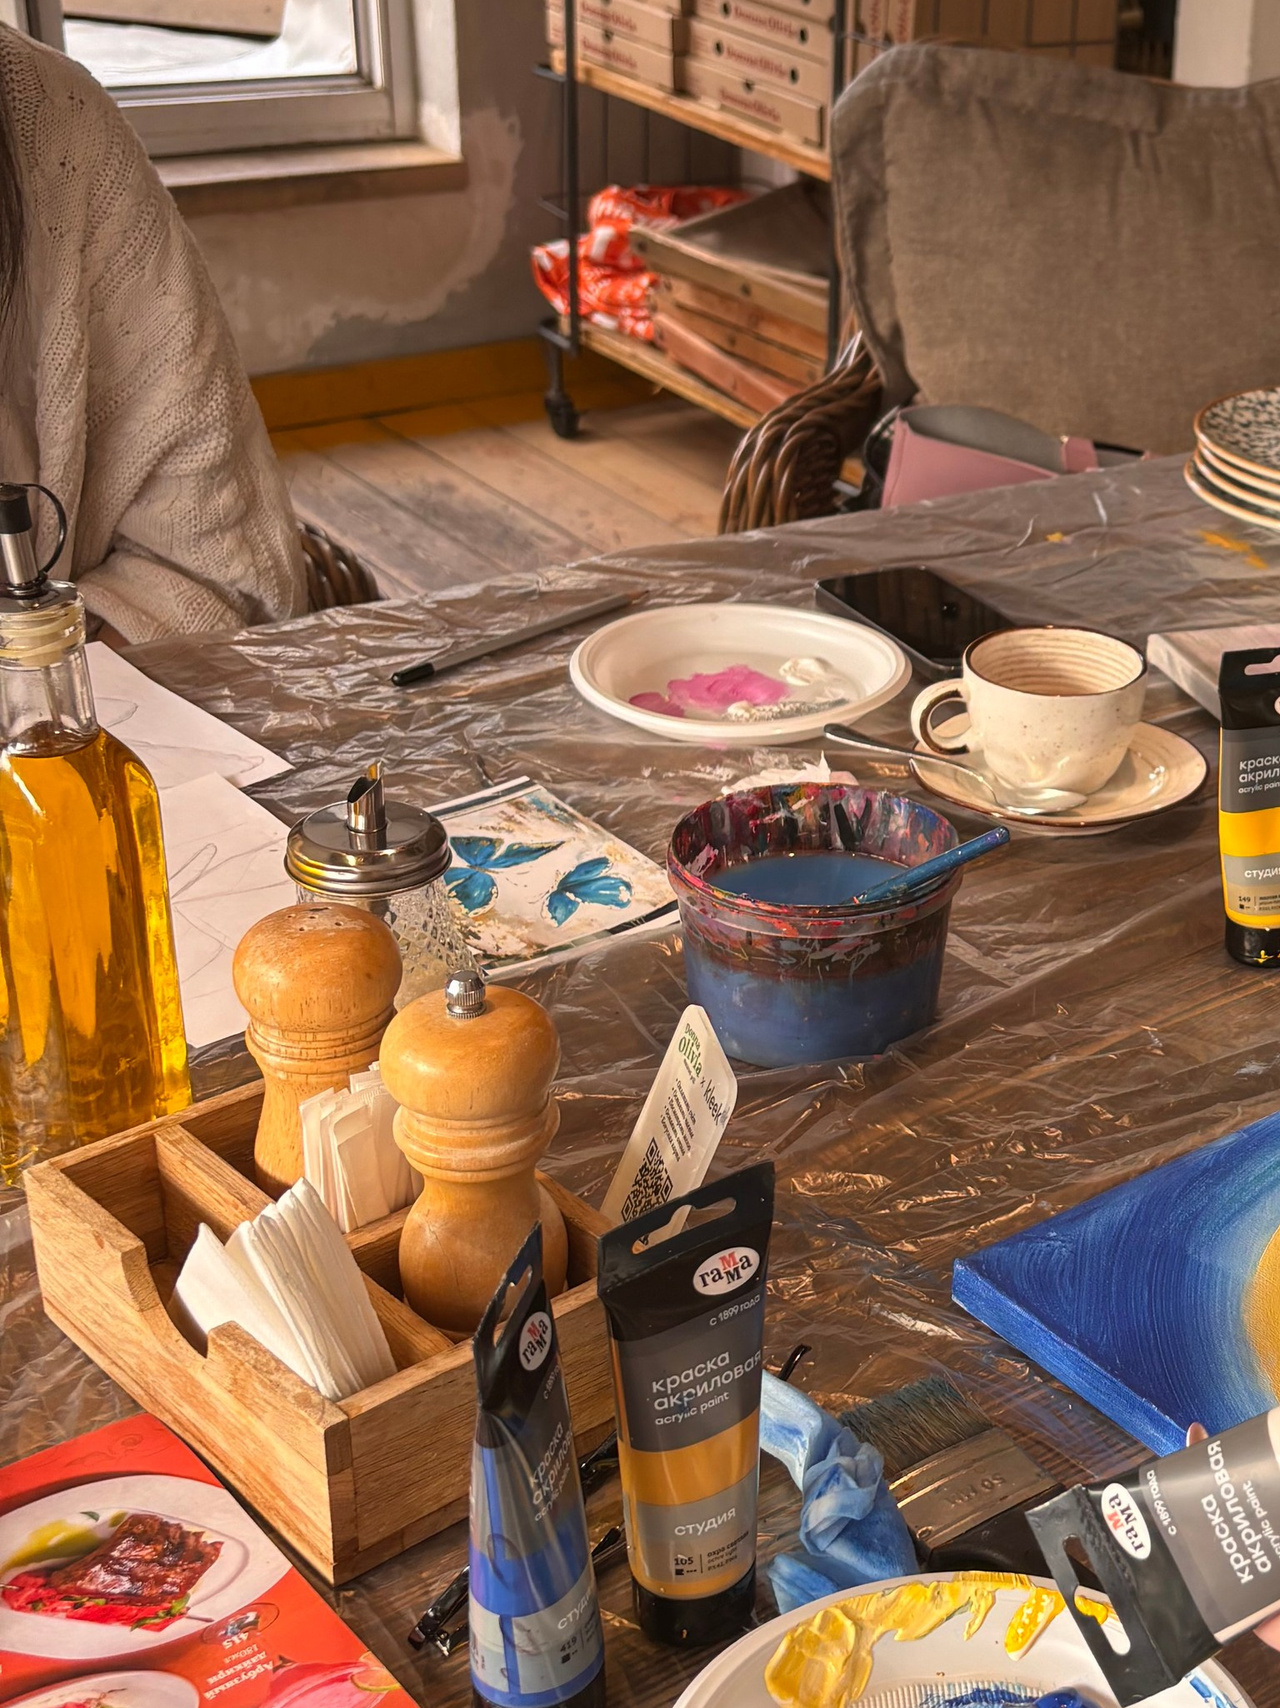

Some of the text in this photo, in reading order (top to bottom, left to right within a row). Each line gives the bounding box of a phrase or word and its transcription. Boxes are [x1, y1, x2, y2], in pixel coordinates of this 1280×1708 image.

[1238, 784, 1263, 794] acrylic
[684, 1023, 701, 1050] Donna
[703, 1079, 722, 1126] kleek
[709, 1294, 761, 1327] с 1899 года
[652, 1352, 730, 1394] краска
[654, 1350, 761, 1410] акриловая
[700, 1391, 730, 1415] paint
[529, 1422, 563, 1488] краска
[533, 1431, 572, 1504] акрилов
[1147, 1470, 1177, 1535] с 1899 года
[1208, 1440, 1272, 1573] акриловая
[1243, 1479, 1268, 1519] paint
[674, 1507, 736, 1535] студия
[1201, 1494, 1254, 1584] краска
[674, 1557, 694, 1566] 105
[222, 1632, 249, 1649] 415
[560, 1636, 577, 1652] 419
